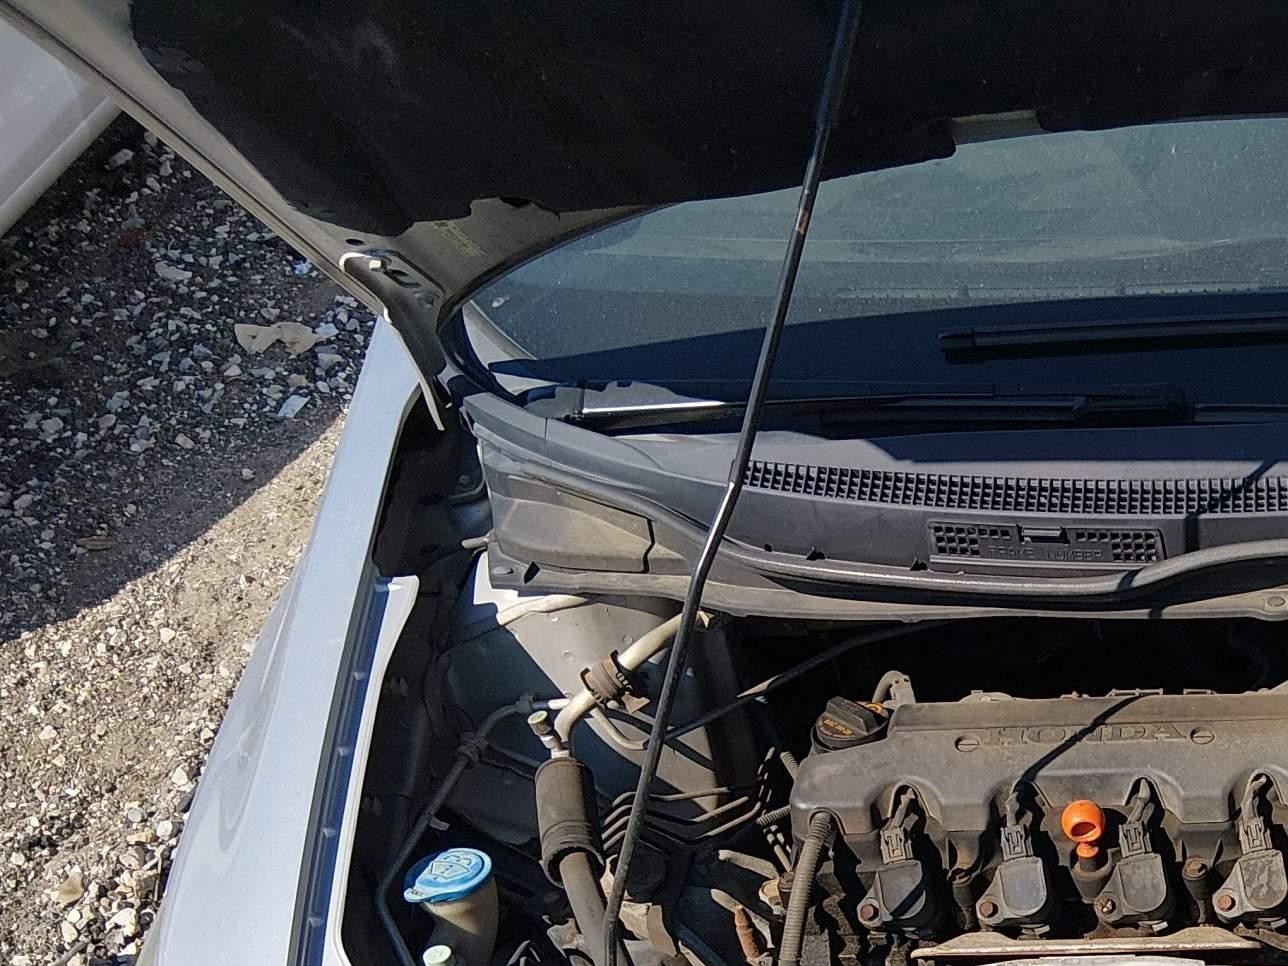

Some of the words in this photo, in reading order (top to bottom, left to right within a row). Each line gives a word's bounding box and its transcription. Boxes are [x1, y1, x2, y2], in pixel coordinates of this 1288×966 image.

[989, 545, 1036, 559] FRAME
[1046, 547, 1105, 561] NUMBER
[983, 723, 1187, 746] HONDA
